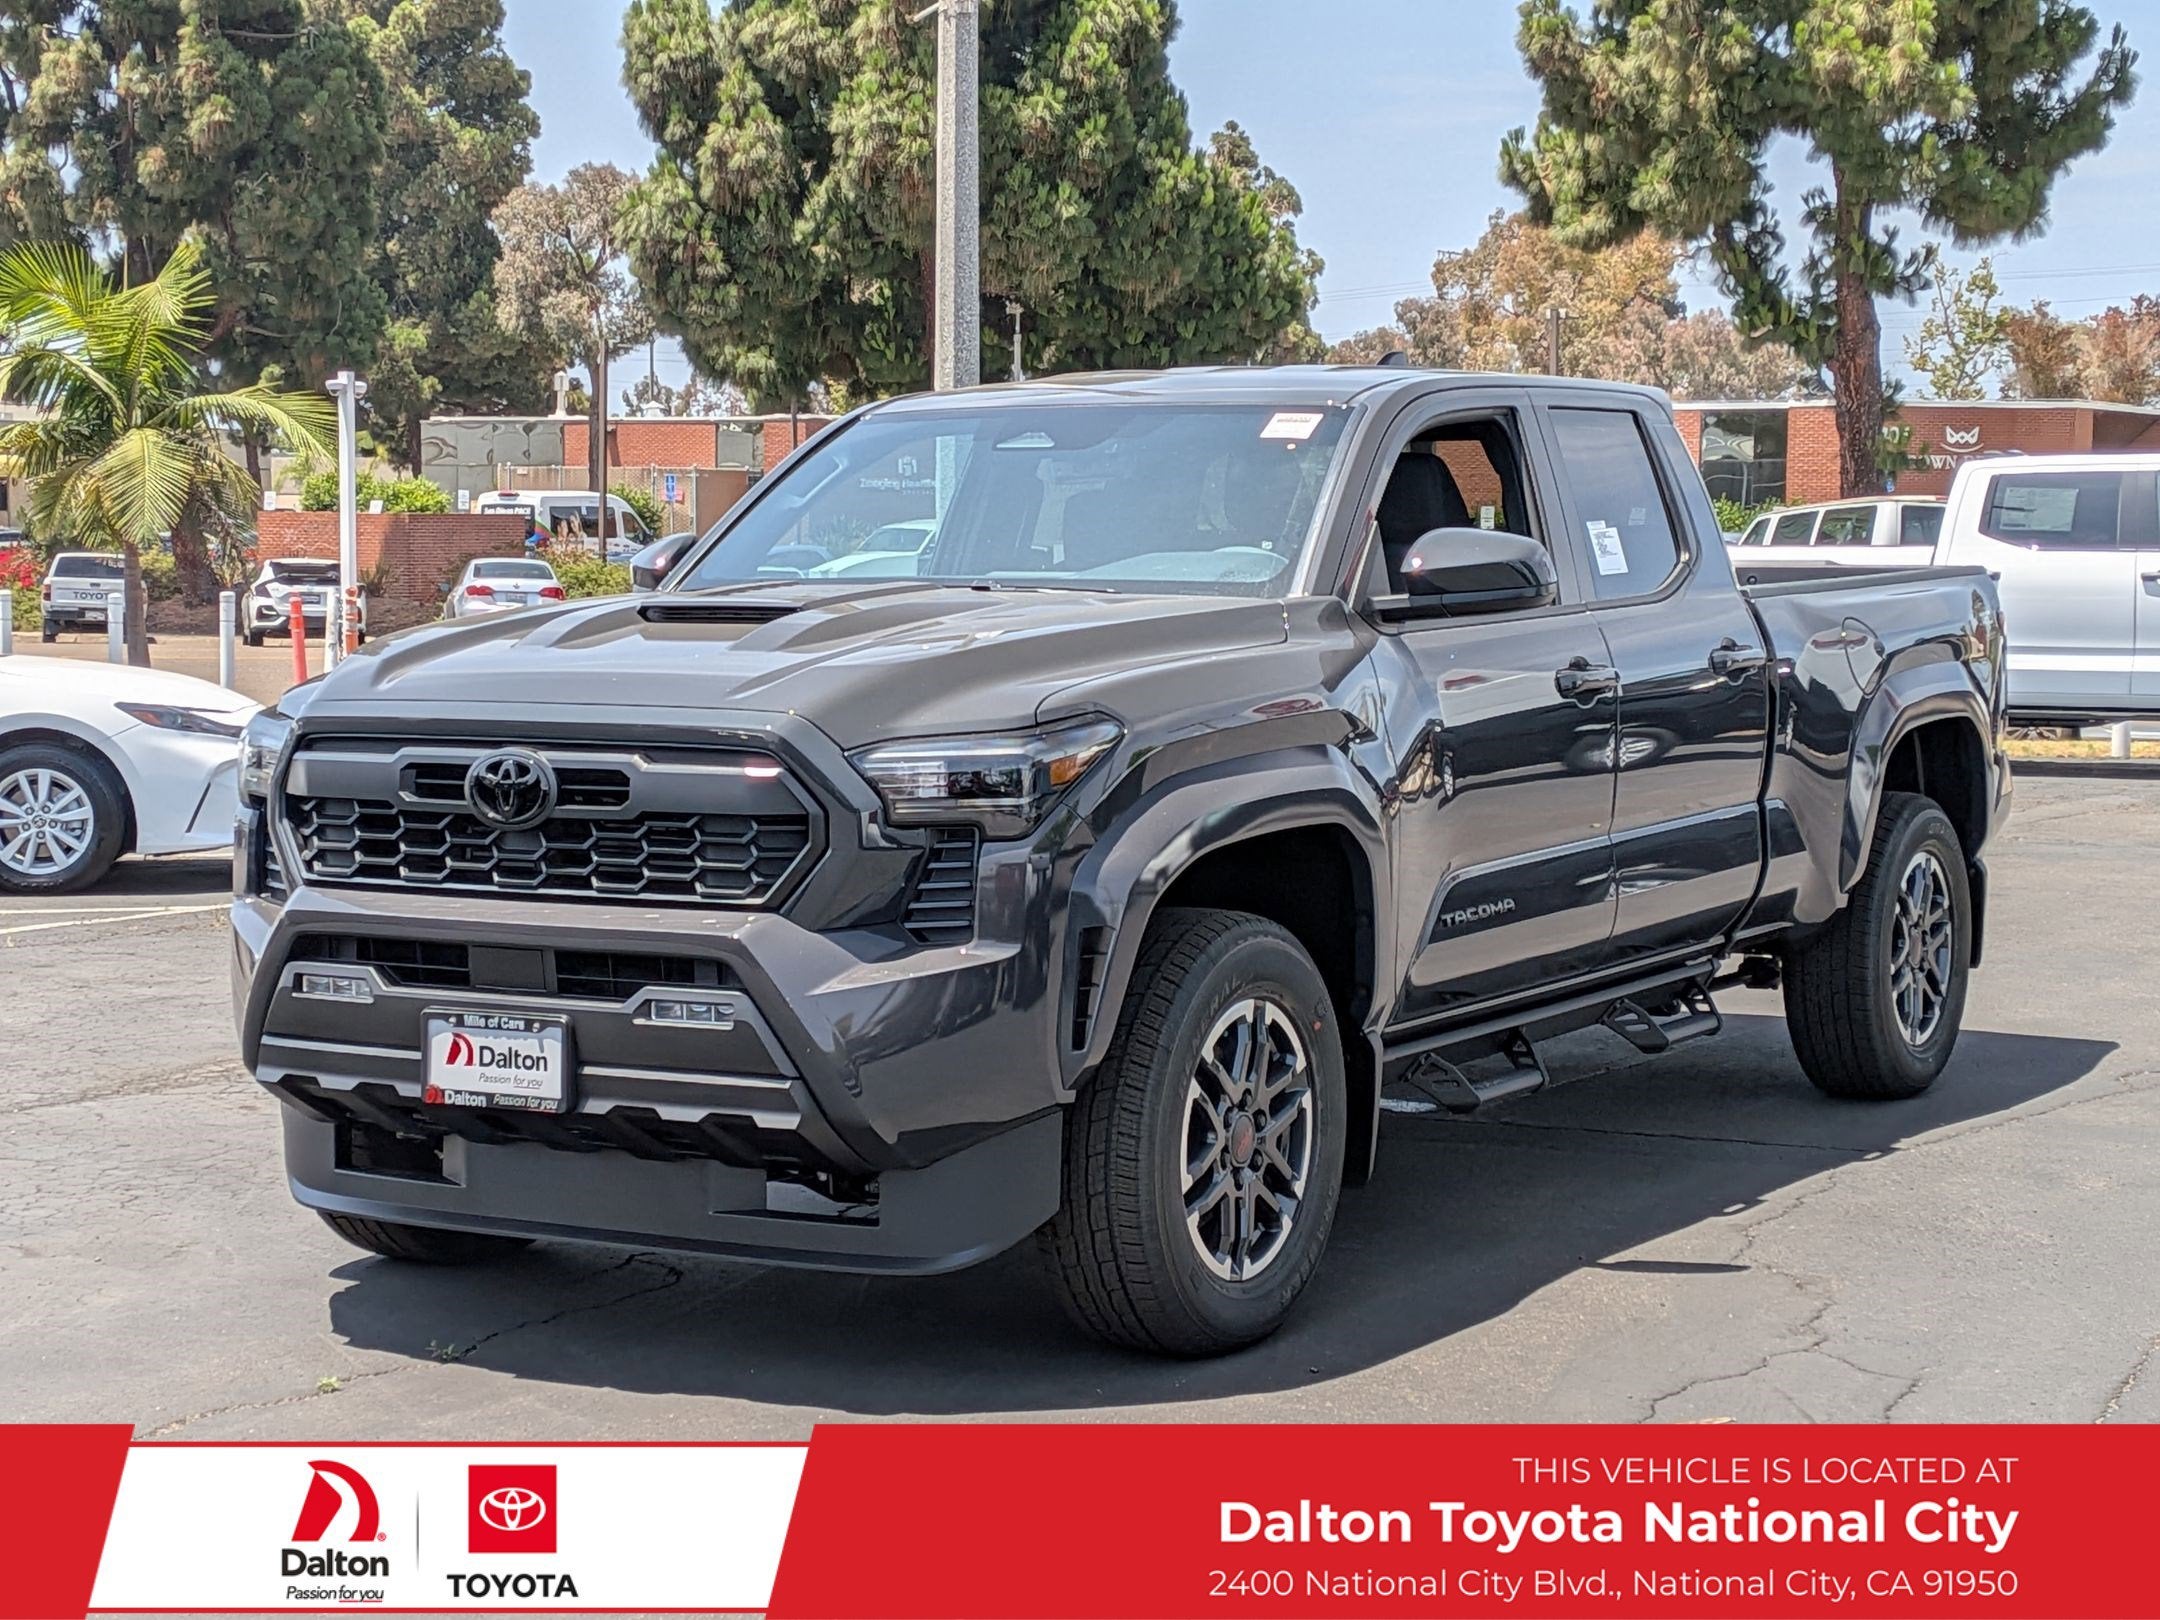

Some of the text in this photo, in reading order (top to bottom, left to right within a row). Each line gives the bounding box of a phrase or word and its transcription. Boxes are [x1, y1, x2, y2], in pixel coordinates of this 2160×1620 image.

[73, 591, 108, 600] TOYOT
[1441, 897, 1516, 927] TACOMA
[464, 1014, 526, 1030] Mile of Cars
[479, 1045, 548, 1072] Dalton
[478, 1073, 543, 1087] Passion for you
[444, 1090, 558, 1110] Dalton Passion for you
